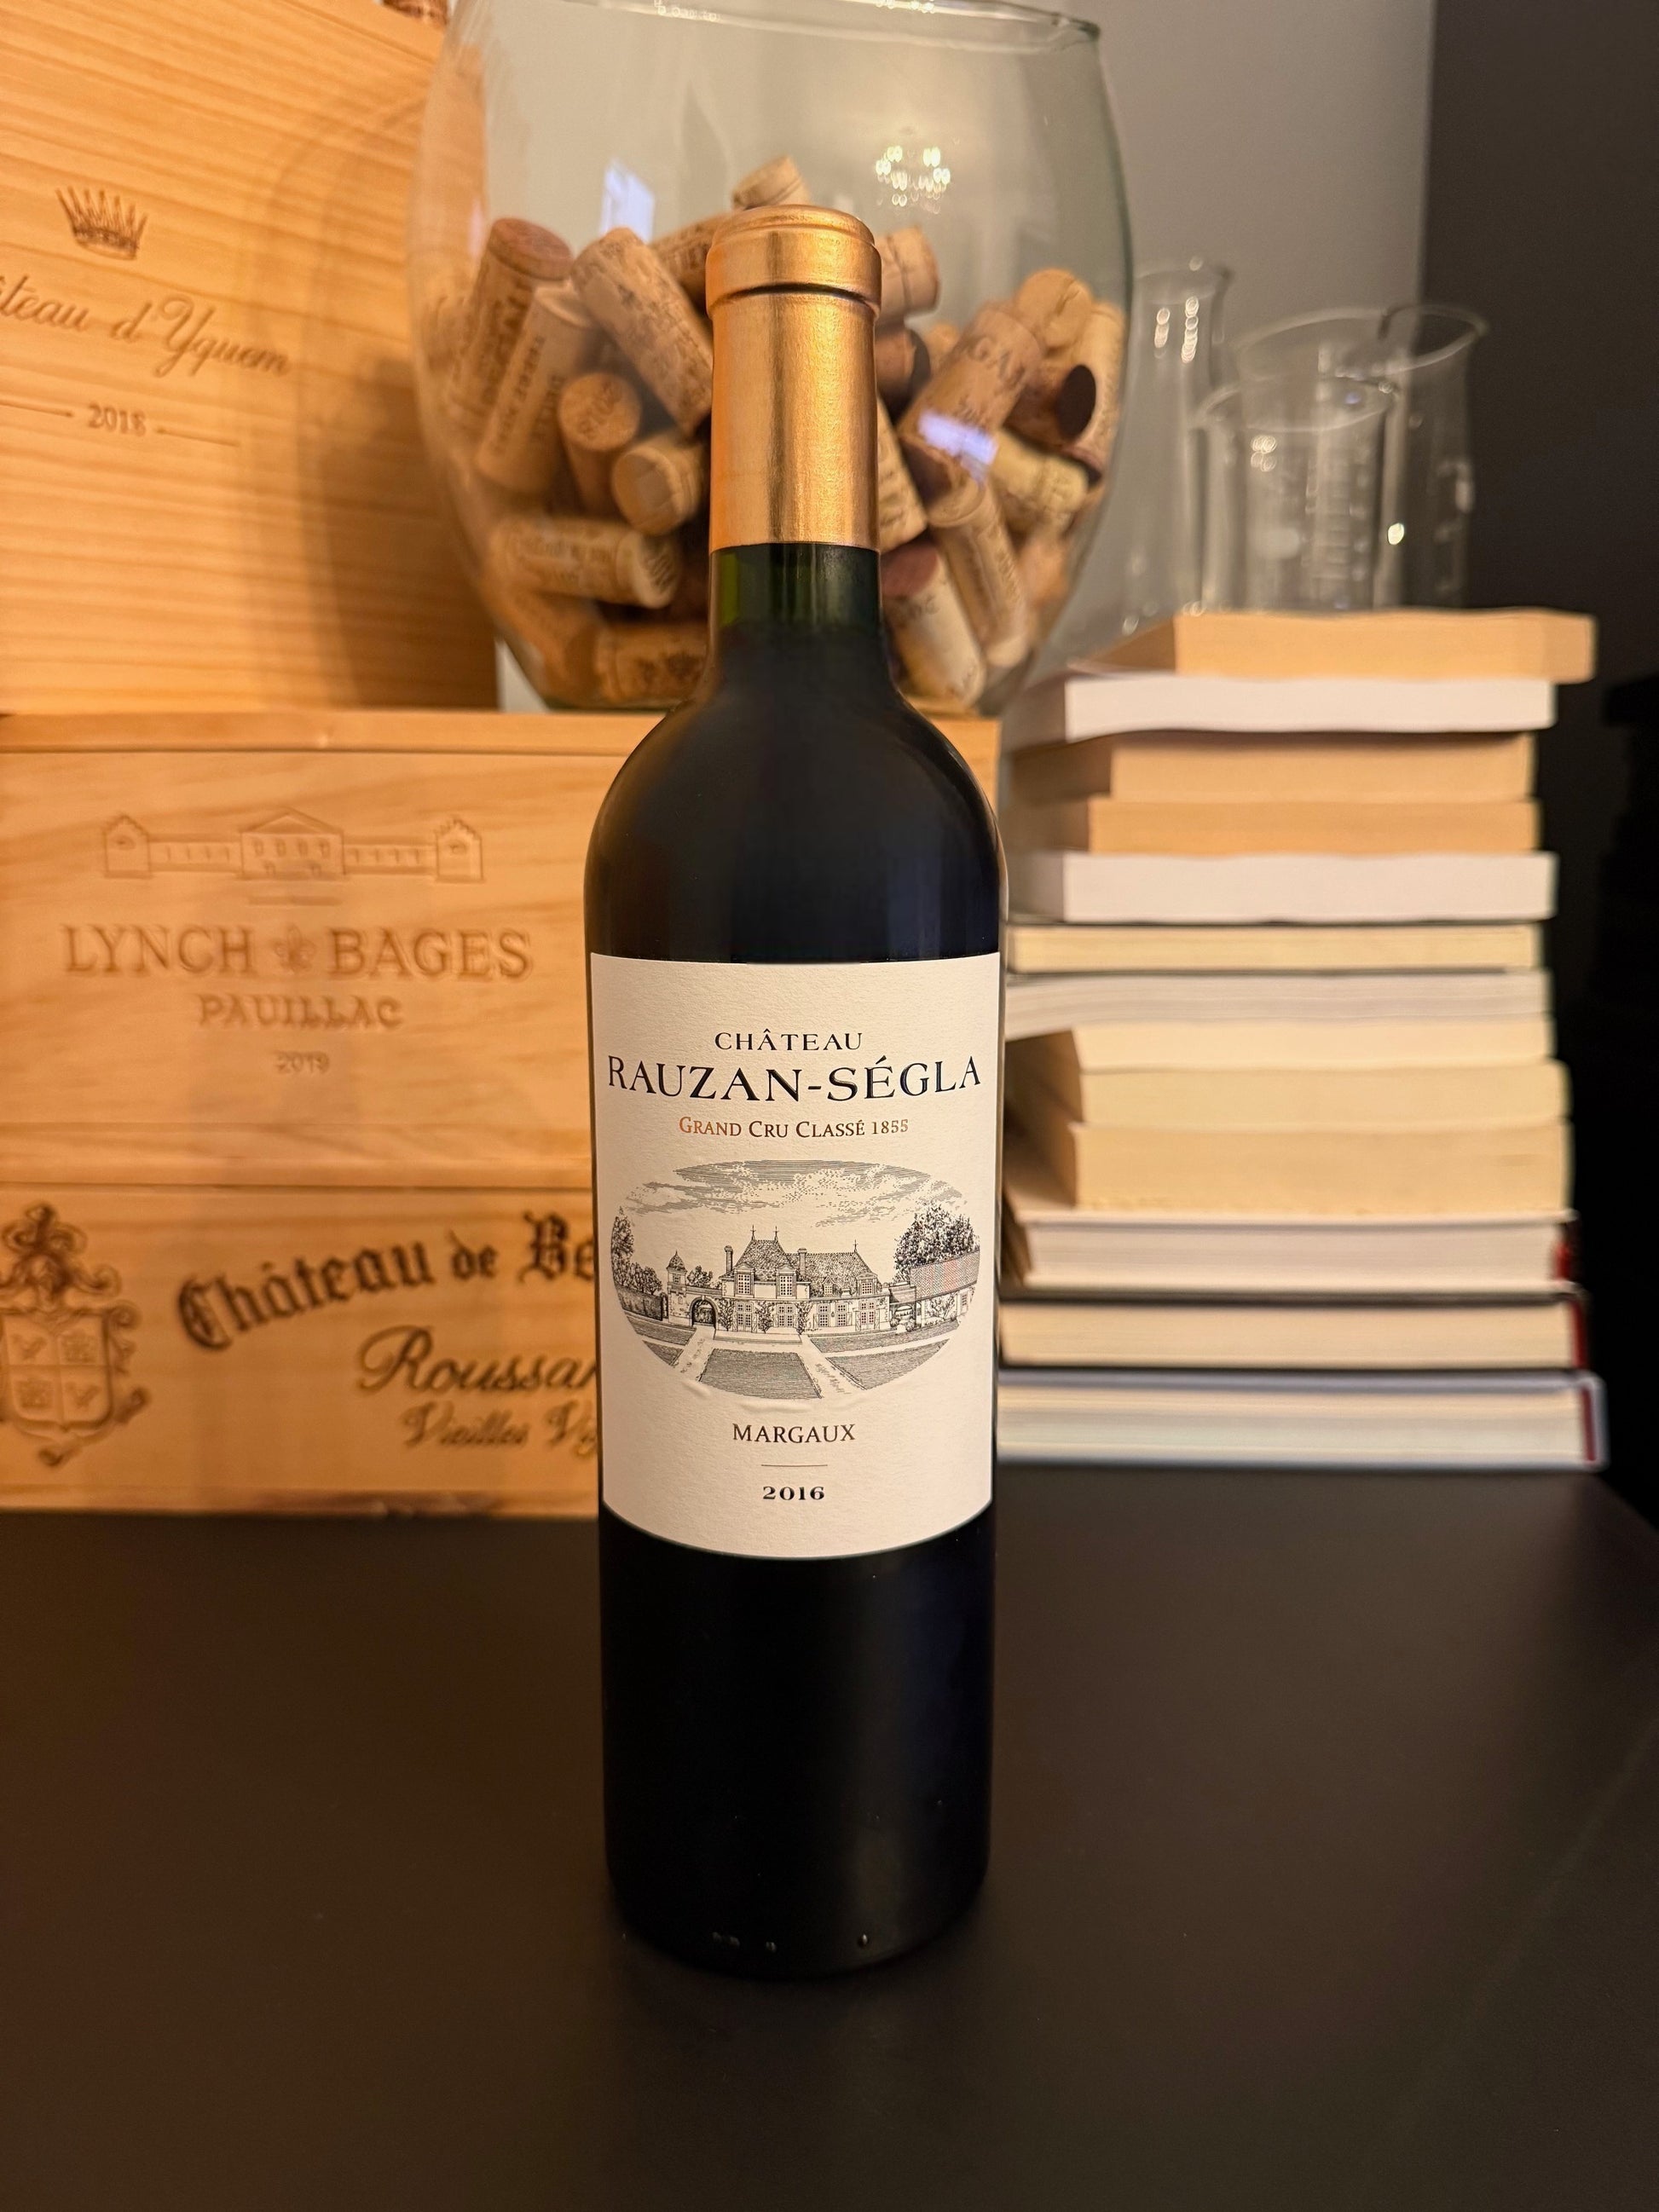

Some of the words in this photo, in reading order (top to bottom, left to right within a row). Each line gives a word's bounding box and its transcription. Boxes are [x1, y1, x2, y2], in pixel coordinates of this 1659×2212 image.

[0, 274, 90, 332] teau
[87, 400, 147, 437] 2018
[62, 924, 255, 977] LYNCH
[327, 927, 534, 981] BAGES
[196, 993, 404, 1029] PAUILLAC
[714, 1028, 864, 1051] CHÂTEAU
[608, 1054, 982, 1103] RAUZAN-SÉGLA
[871, 1118, 909, 1135] 1855
[177, 1240, 438, 1352] Château
[446, 1227, 498, 1280] de
[732, 1423, 856, 1444] MARGAUX
[762, 1486, 825, 1501] 2016
